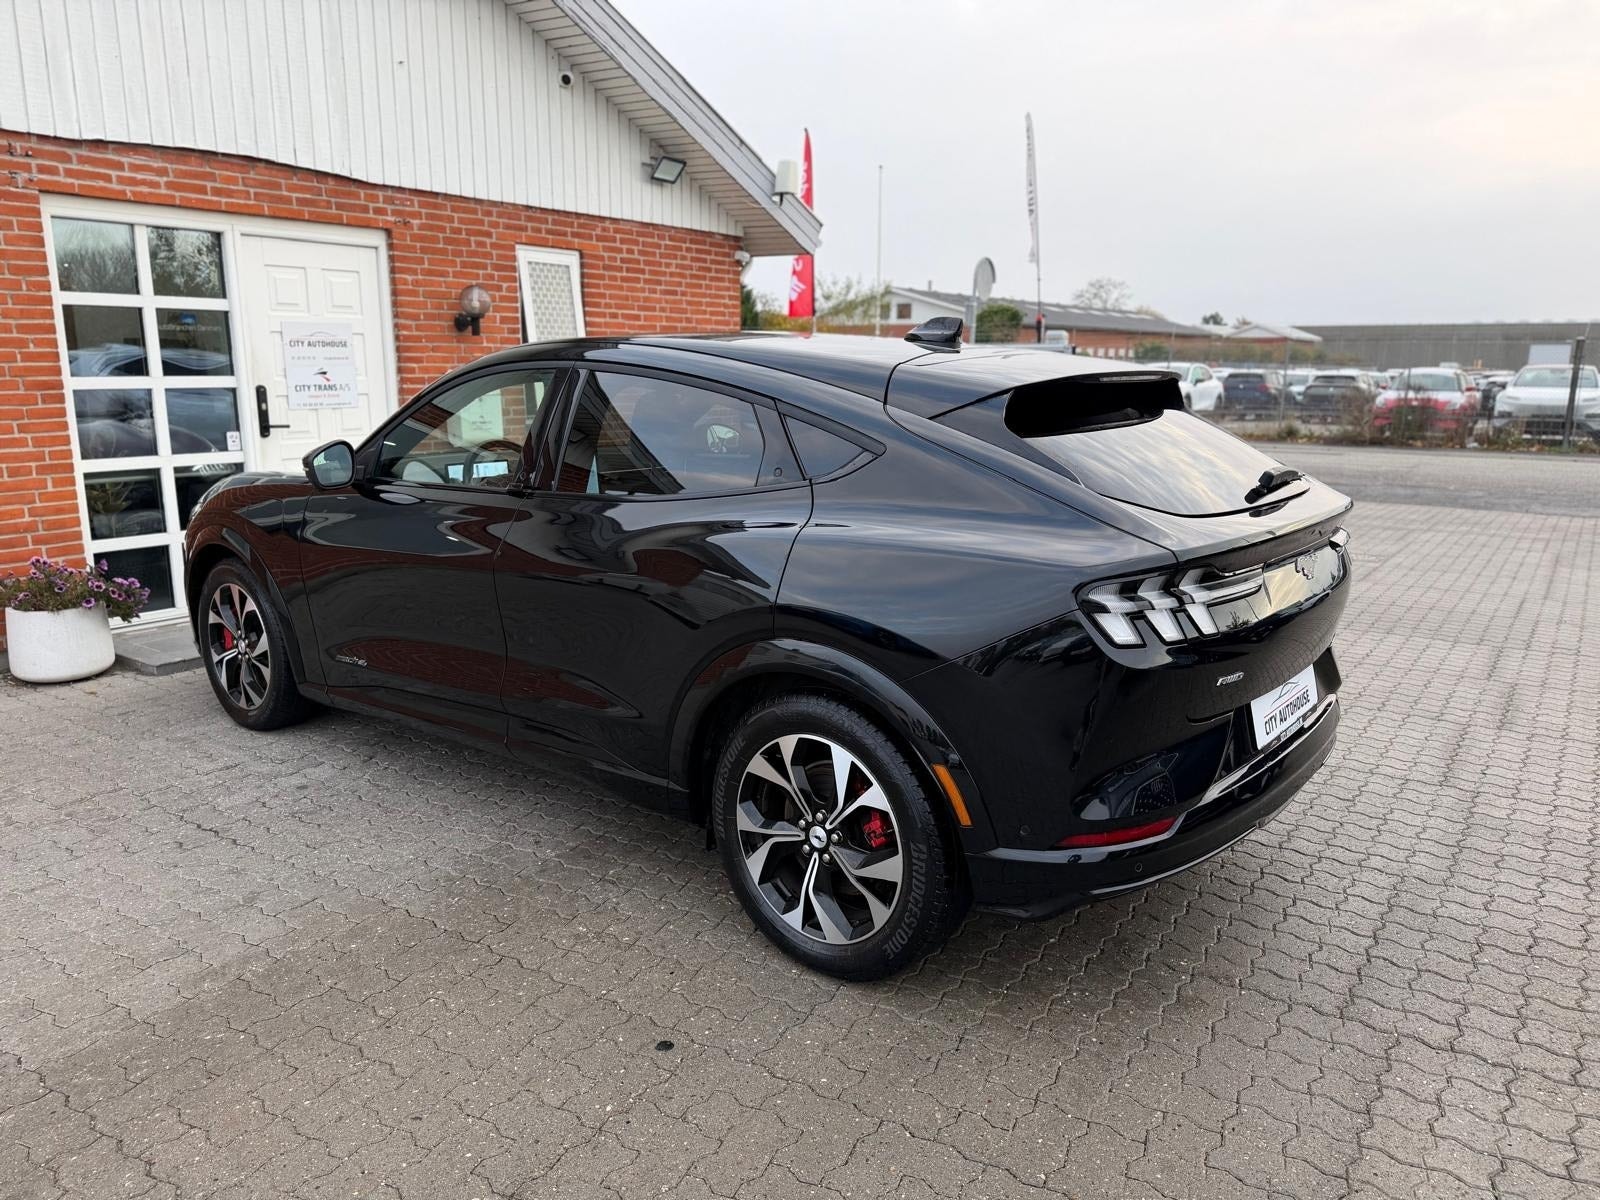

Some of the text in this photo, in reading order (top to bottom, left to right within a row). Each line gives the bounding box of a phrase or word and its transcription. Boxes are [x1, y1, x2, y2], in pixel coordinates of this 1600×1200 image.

[289, 340, 348, 348] CITY AUTOHOUSE
[294, 383, 351, 392] CITY TRANS A/S
[1264, 714, 1278, 736] CITY
[1280, 689, 1310, 724] AUTOHOUSE
[713, 735, 746, 840] BRIDGESTONE
[881, 842, 928, 960] BRIDGESTONE
